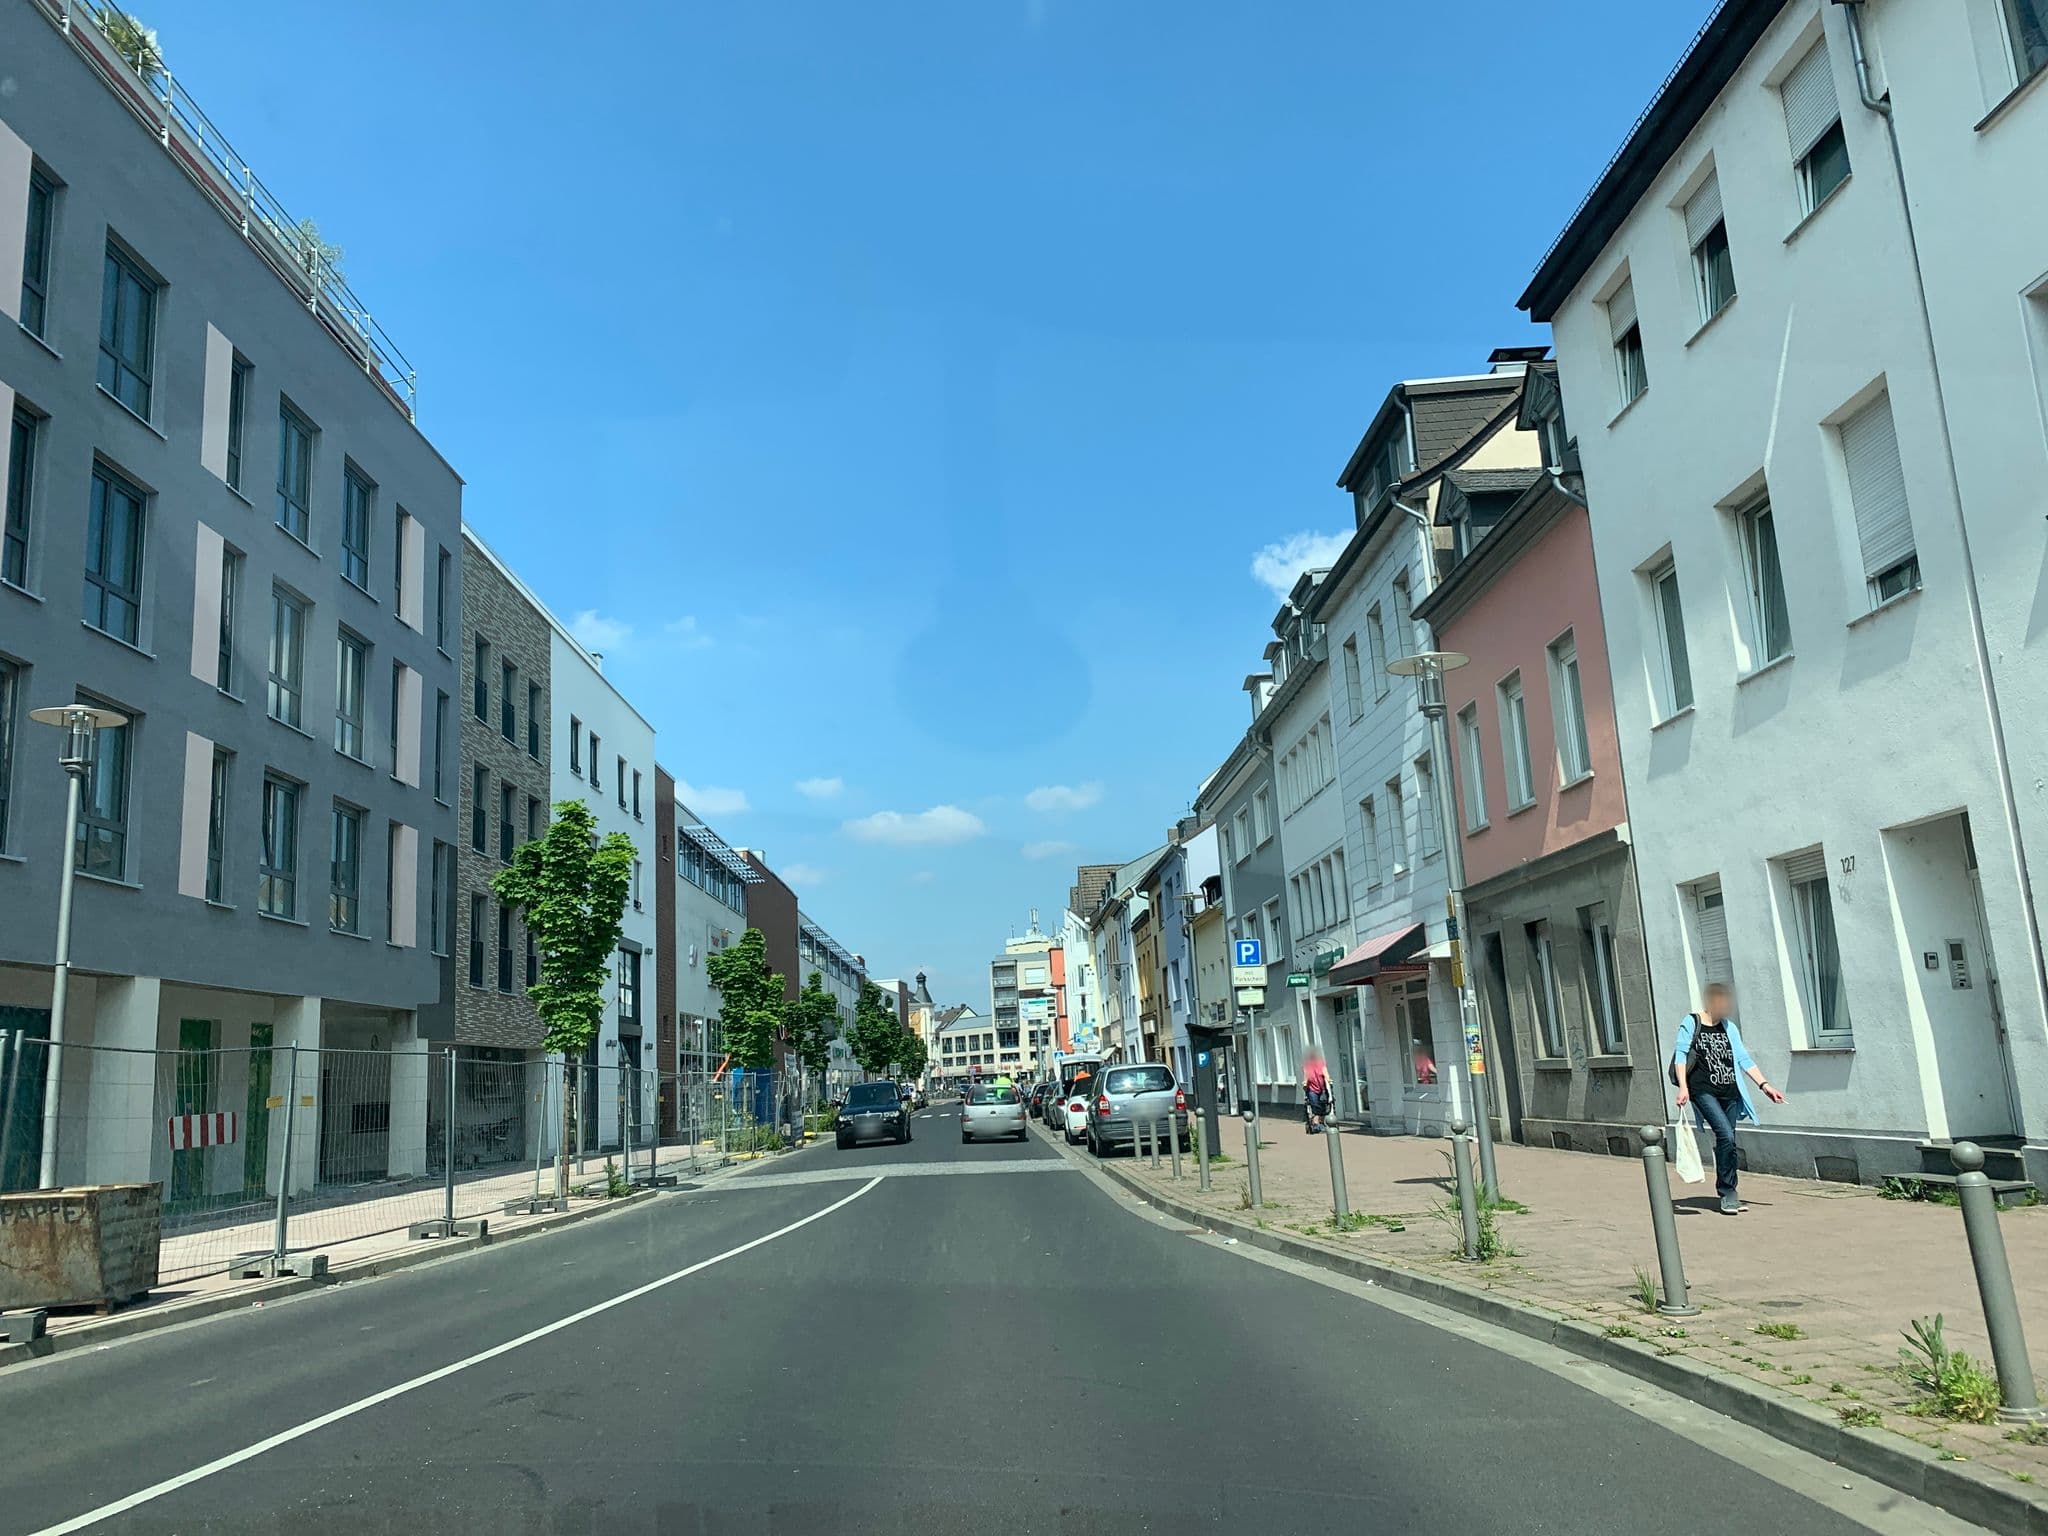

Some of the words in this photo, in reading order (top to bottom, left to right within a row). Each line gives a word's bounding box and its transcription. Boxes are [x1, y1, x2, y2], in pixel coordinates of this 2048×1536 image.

[1840, 855, 1855, 874] 127
[1240, 943, 1255, 963] P
[1198, 1052, 1206, 1065] P
